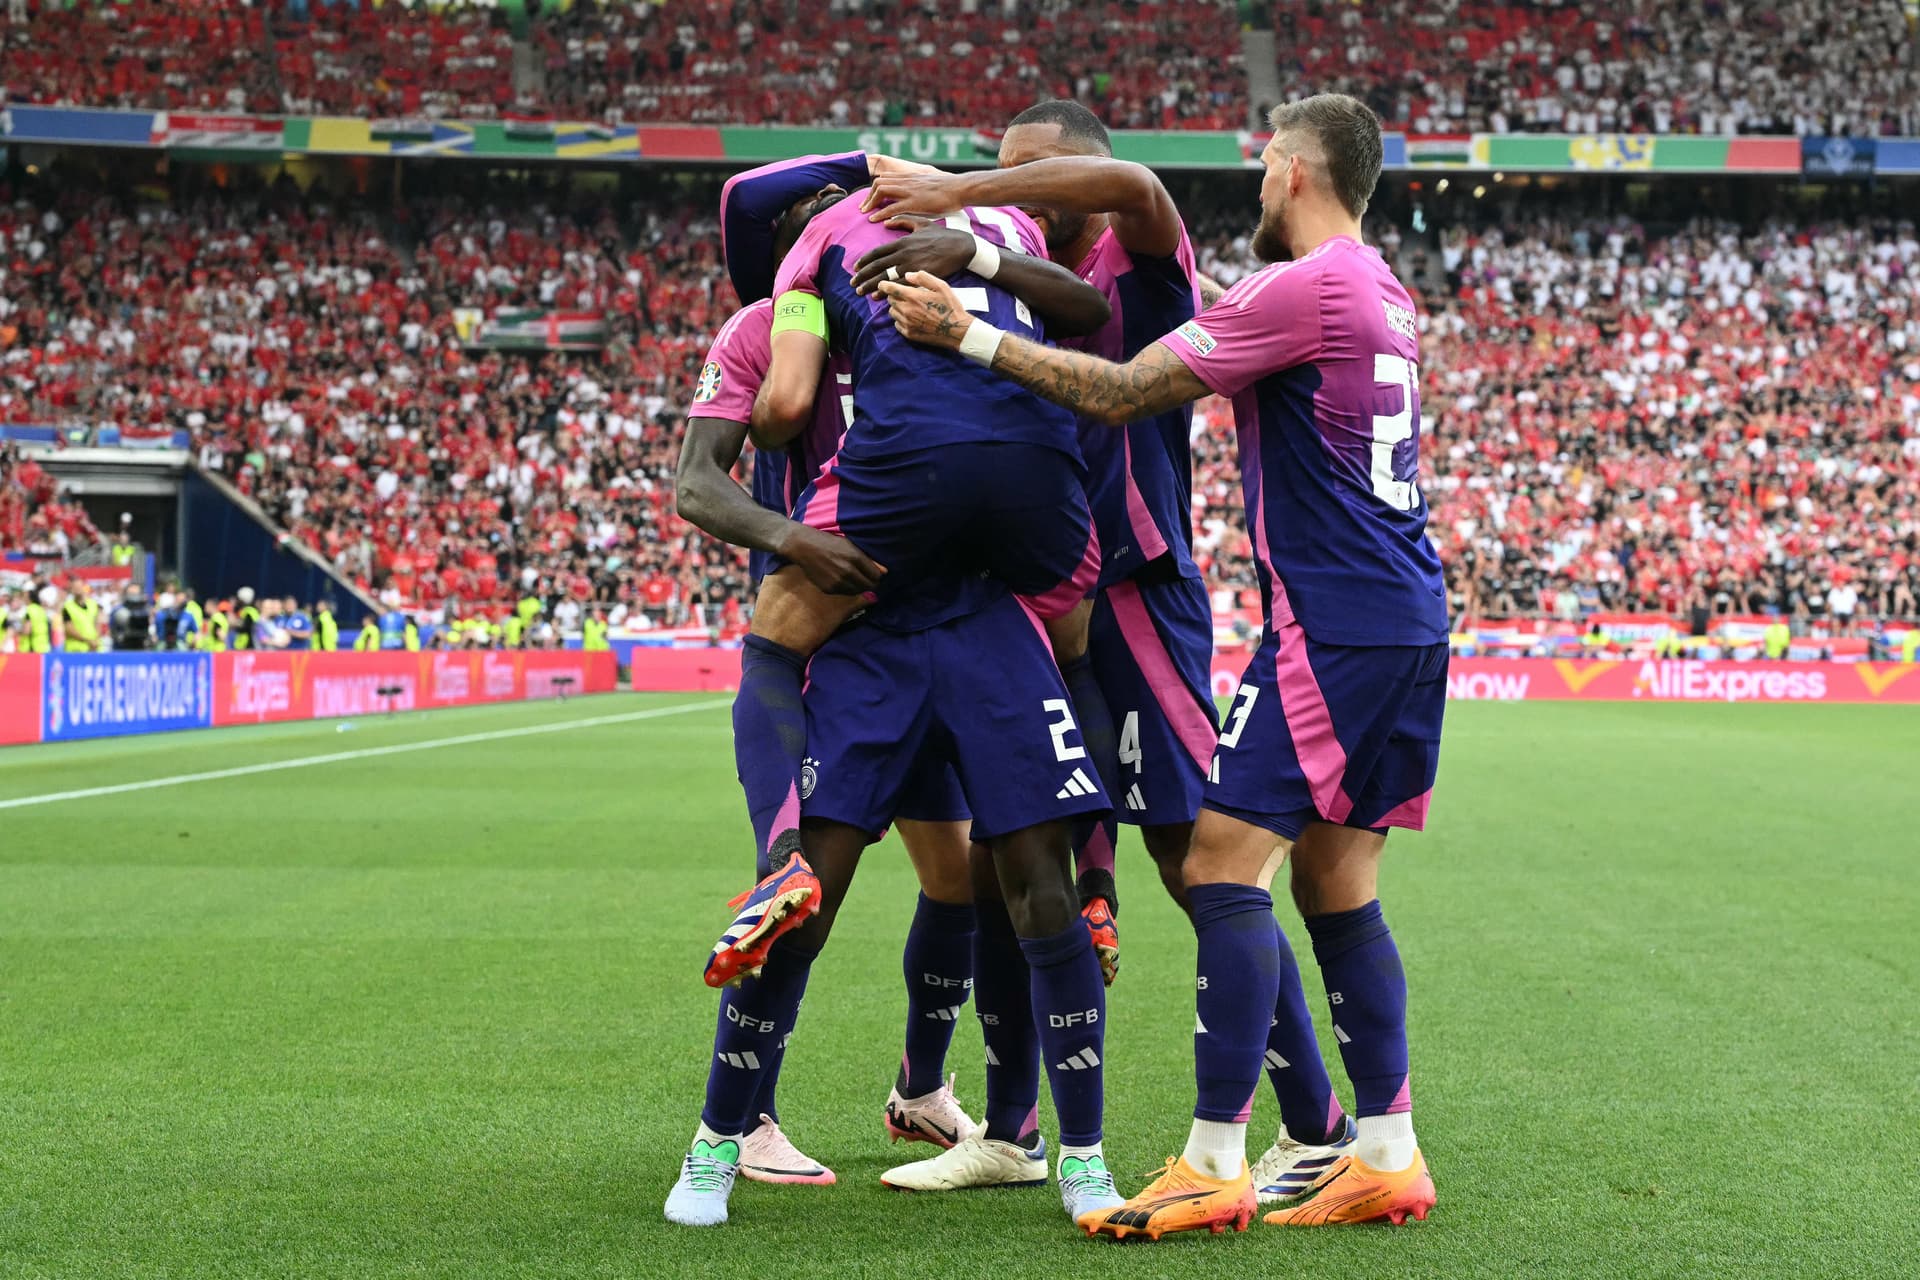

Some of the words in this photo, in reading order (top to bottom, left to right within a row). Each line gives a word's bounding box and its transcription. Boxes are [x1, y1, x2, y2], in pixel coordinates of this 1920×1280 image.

[1632, 660, 1827, 702] AliExpress
[1043, 699, 1086, 762] 2
[1118, 711, 1143, 774] 4
[923, 972, 974, 989] DFB
[725, 1003, 775, 1034] DFB
[1049, 1008, 1099, 1029] DFB
